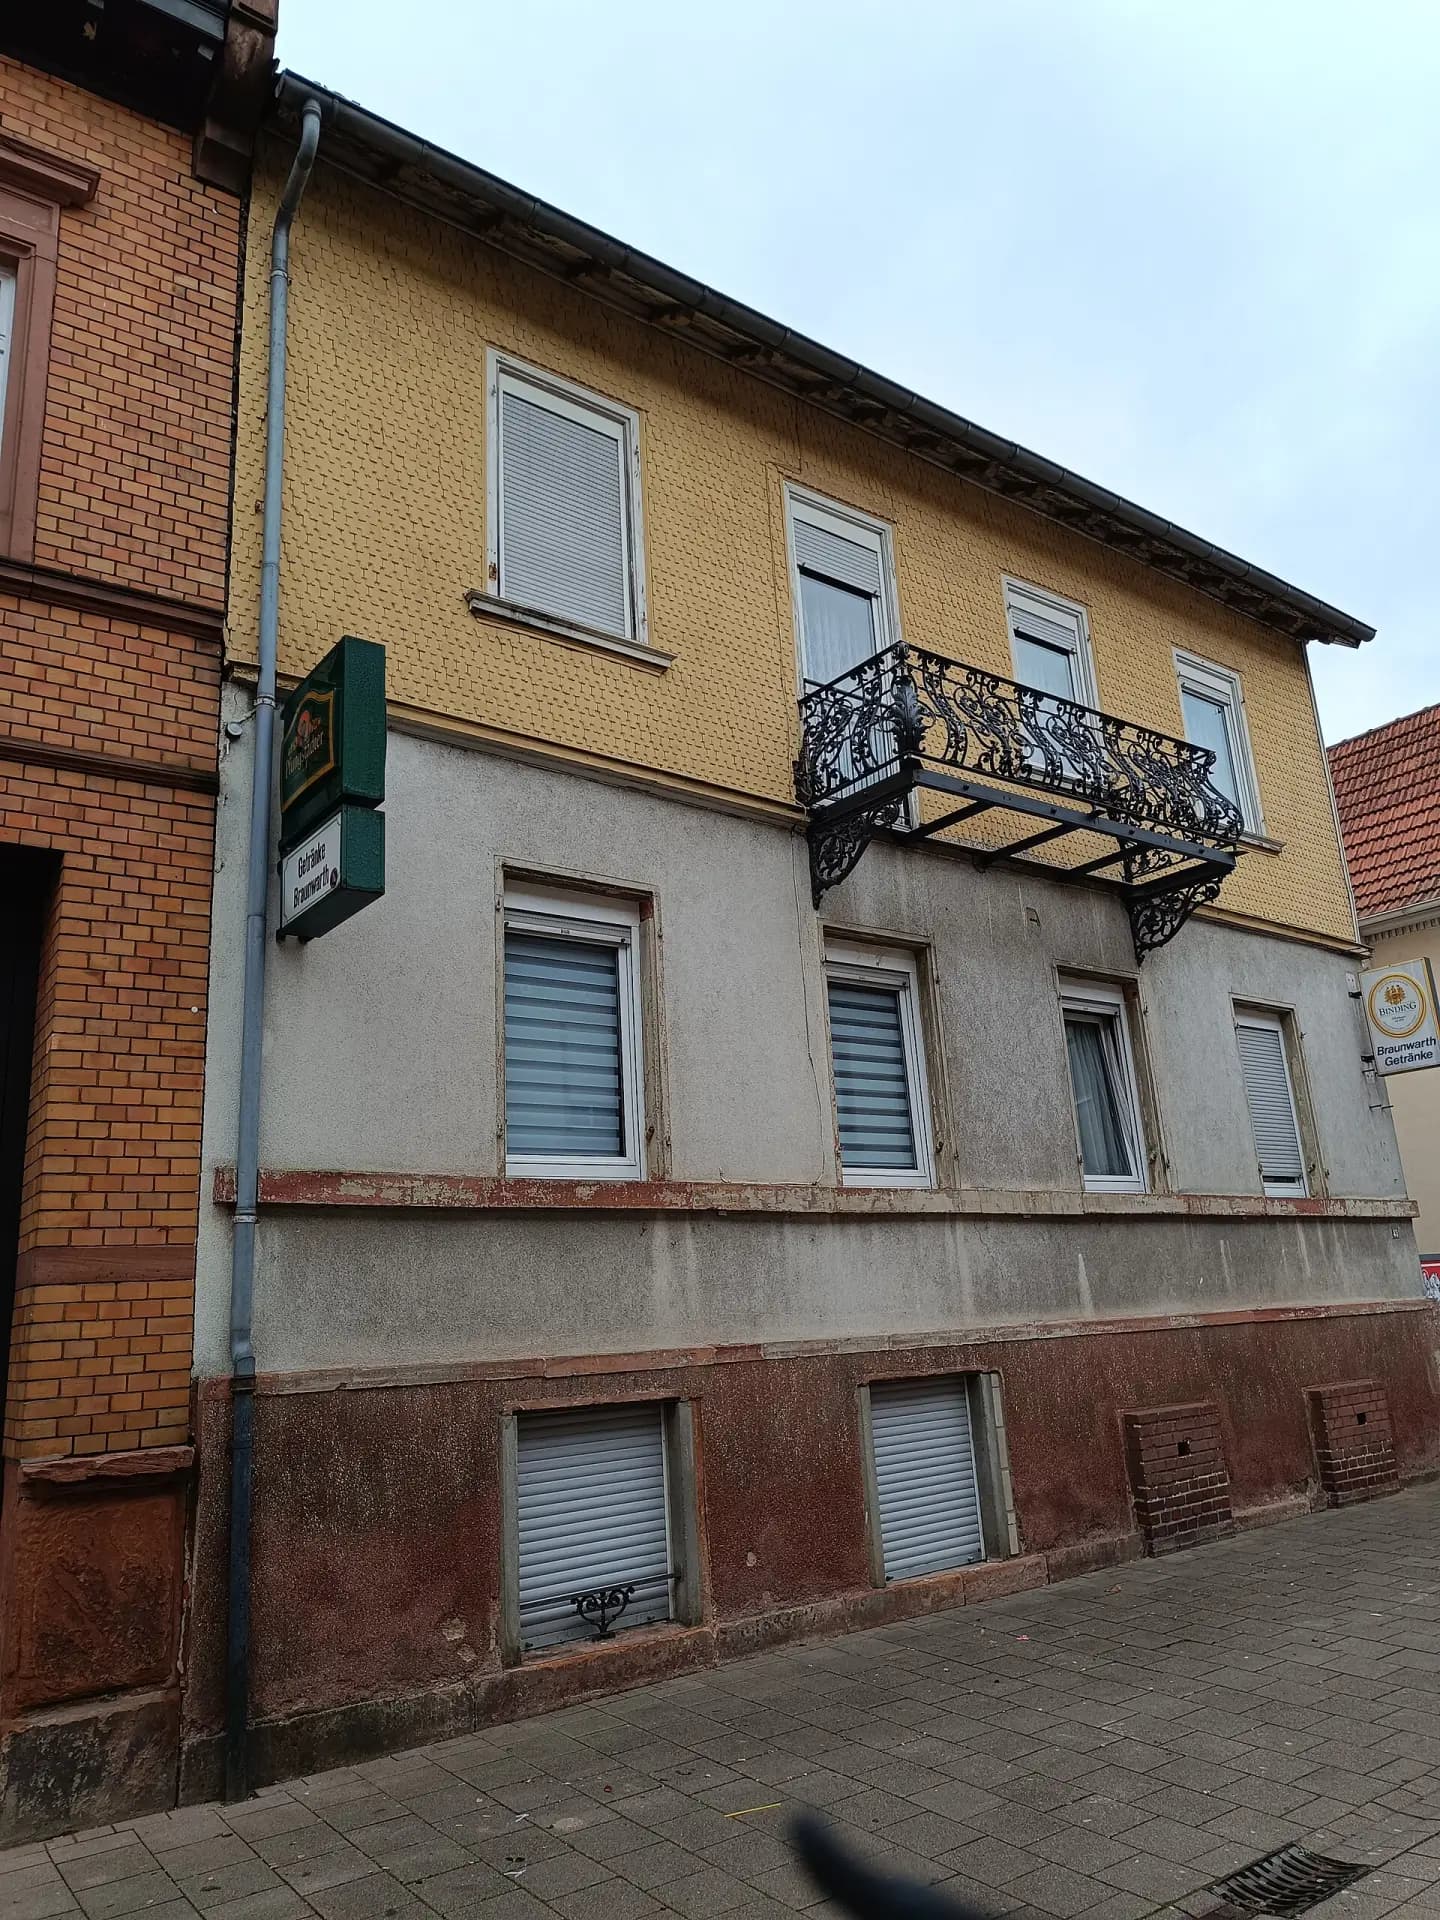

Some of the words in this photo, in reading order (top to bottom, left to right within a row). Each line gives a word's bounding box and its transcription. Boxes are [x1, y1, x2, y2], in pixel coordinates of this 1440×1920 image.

[298, 842, 326, 878] Getränke
[294, 864, 330, 908] Braunwarth
[1379, 1001, 1417, 1017] BINDING
[1377, 1036, 1437, 1056] Braunwarth
[1384, 1050, 1433, 1067] Getränke
